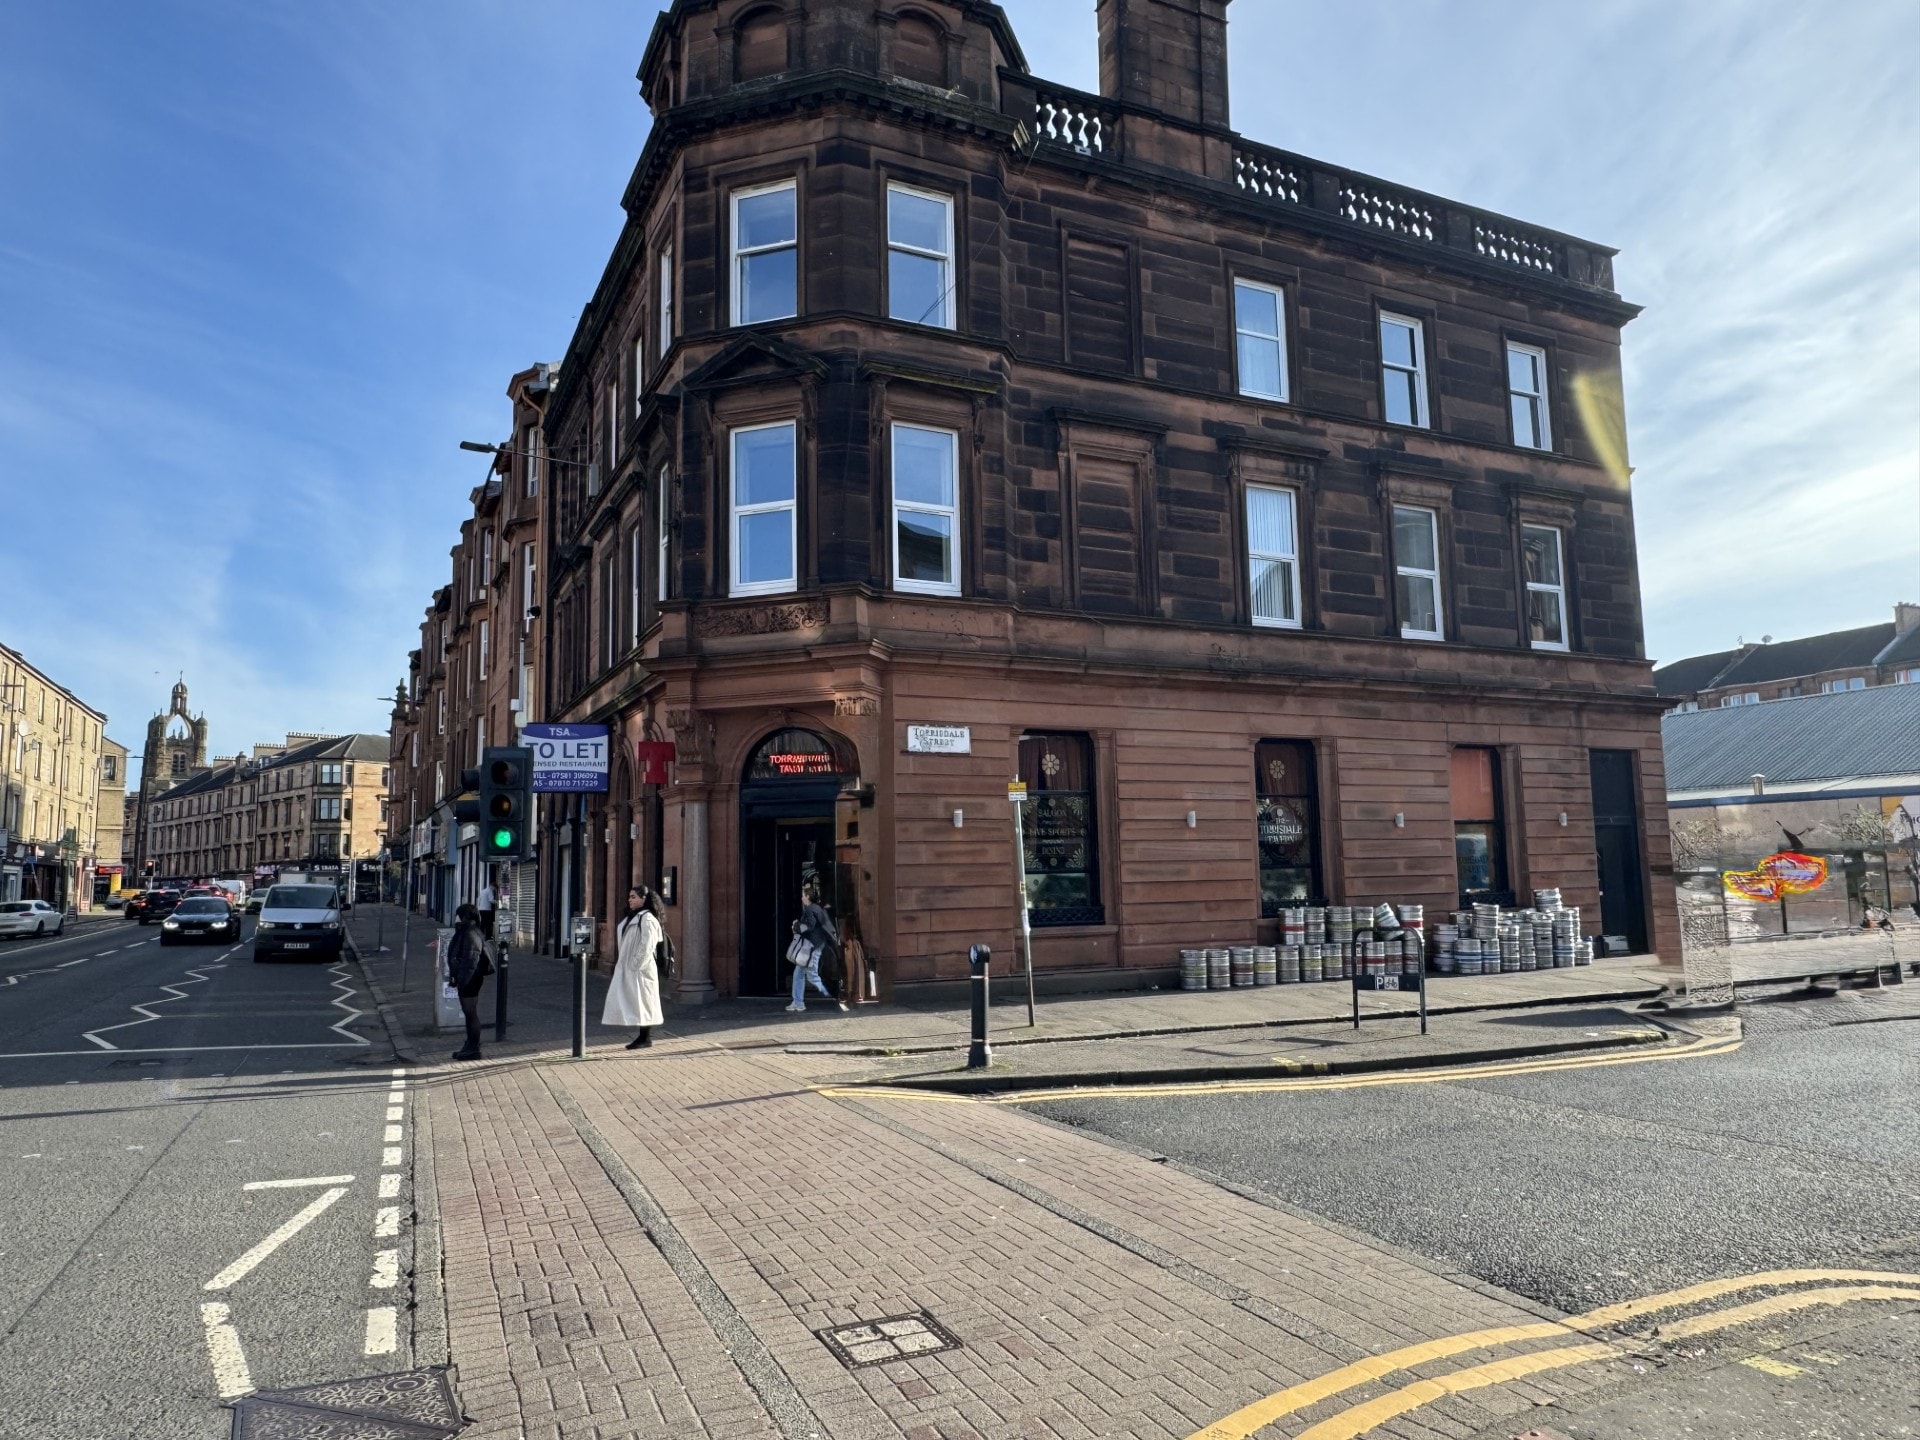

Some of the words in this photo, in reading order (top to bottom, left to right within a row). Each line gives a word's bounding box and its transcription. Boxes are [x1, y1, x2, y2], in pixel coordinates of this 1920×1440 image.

[549, 727, 571, 737] TSA
[562, 742, 604, 759] LET
[1376, 976, 1384, 989] P
